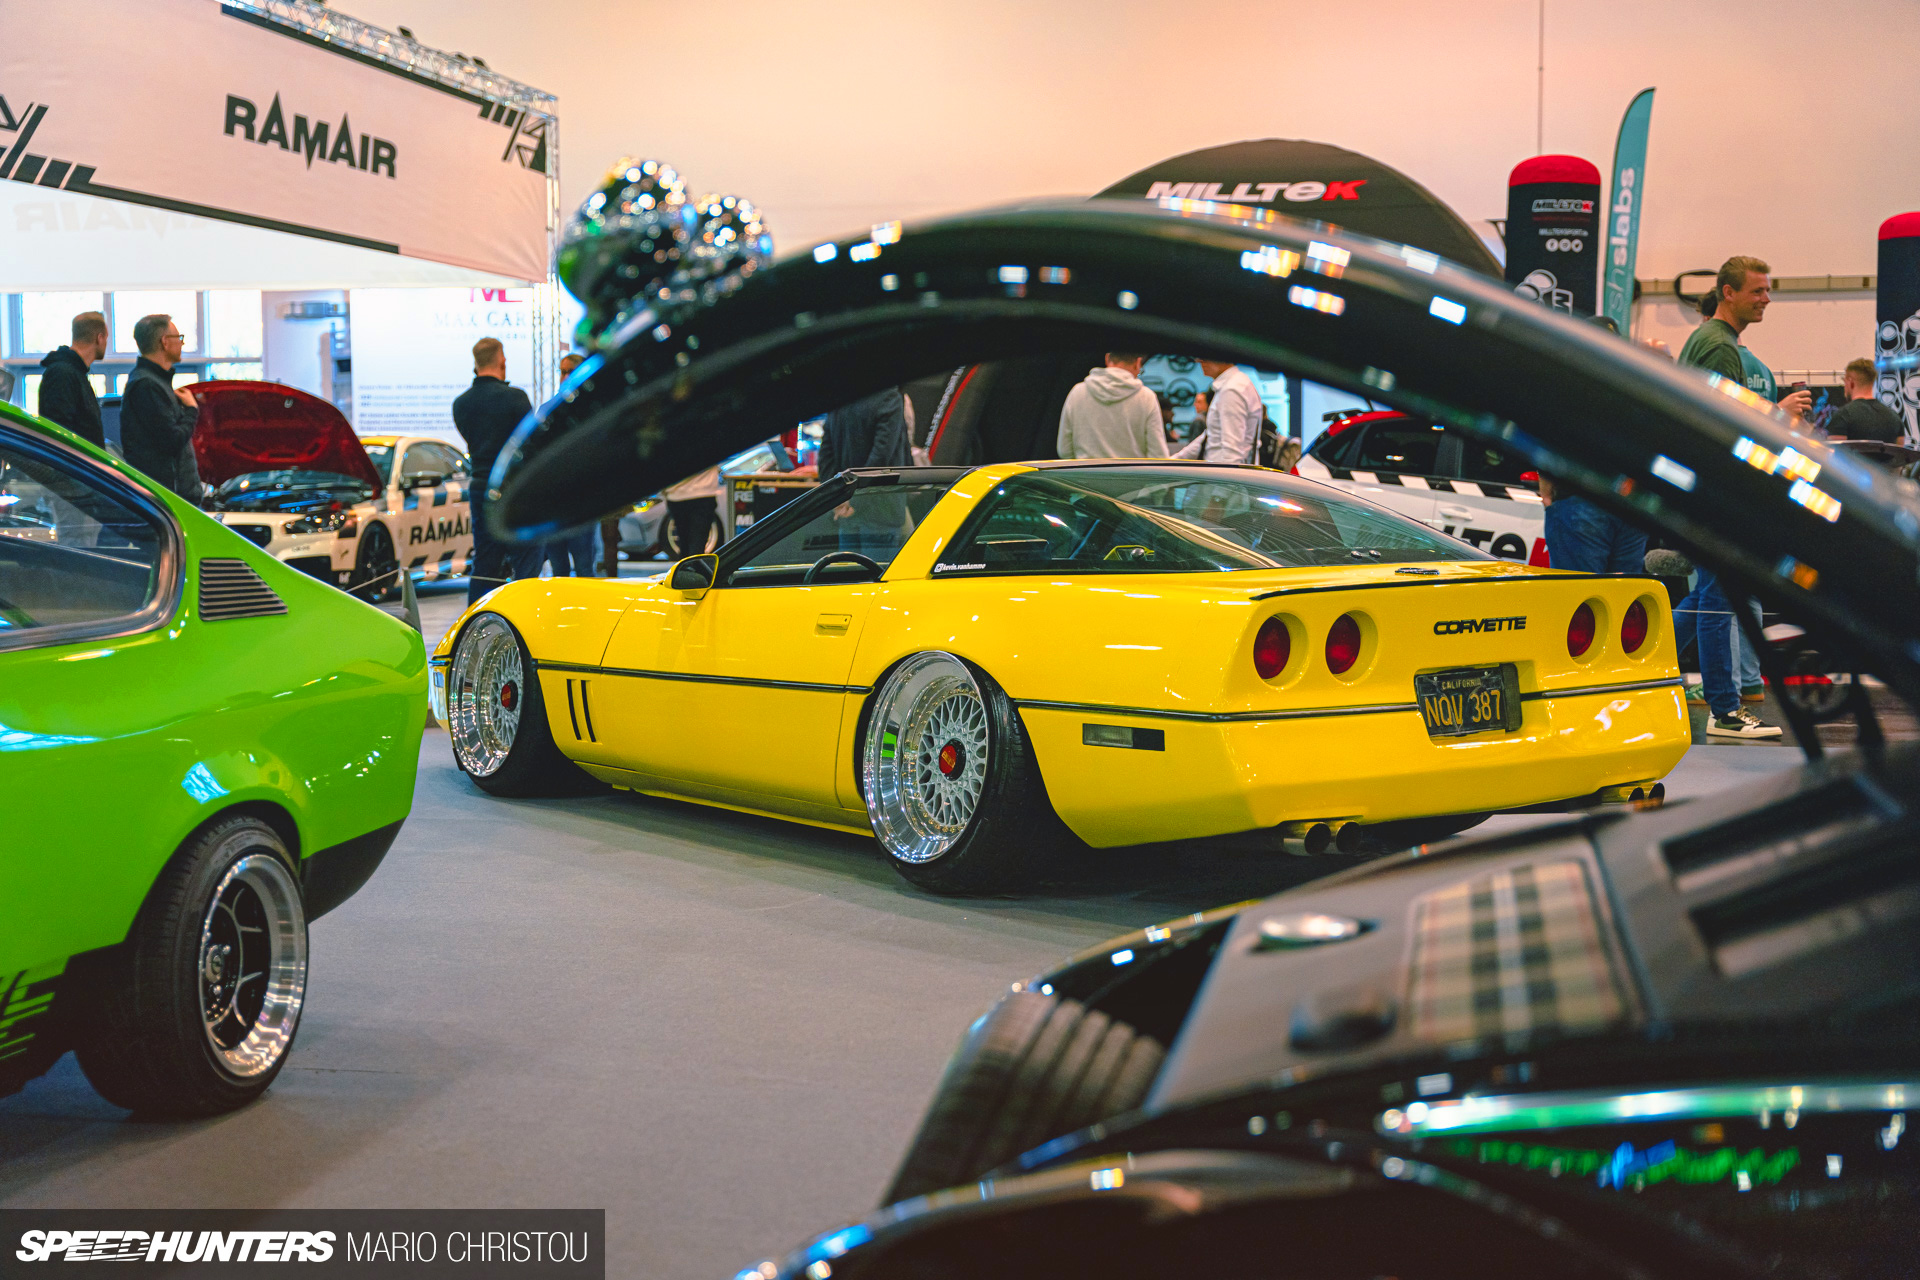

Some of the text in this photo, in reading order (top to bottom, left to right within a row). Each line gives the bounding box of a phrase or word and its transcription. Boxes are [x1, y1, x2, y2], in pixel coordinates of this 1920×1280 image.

[223, 90, 397, 180] RAMAIR
[1433, 616, 1527, 636] CORVETTE
[1441, 677, 1482, 691] CALIFORNIA
[1424, 689, 1501, 728] NQV 387
